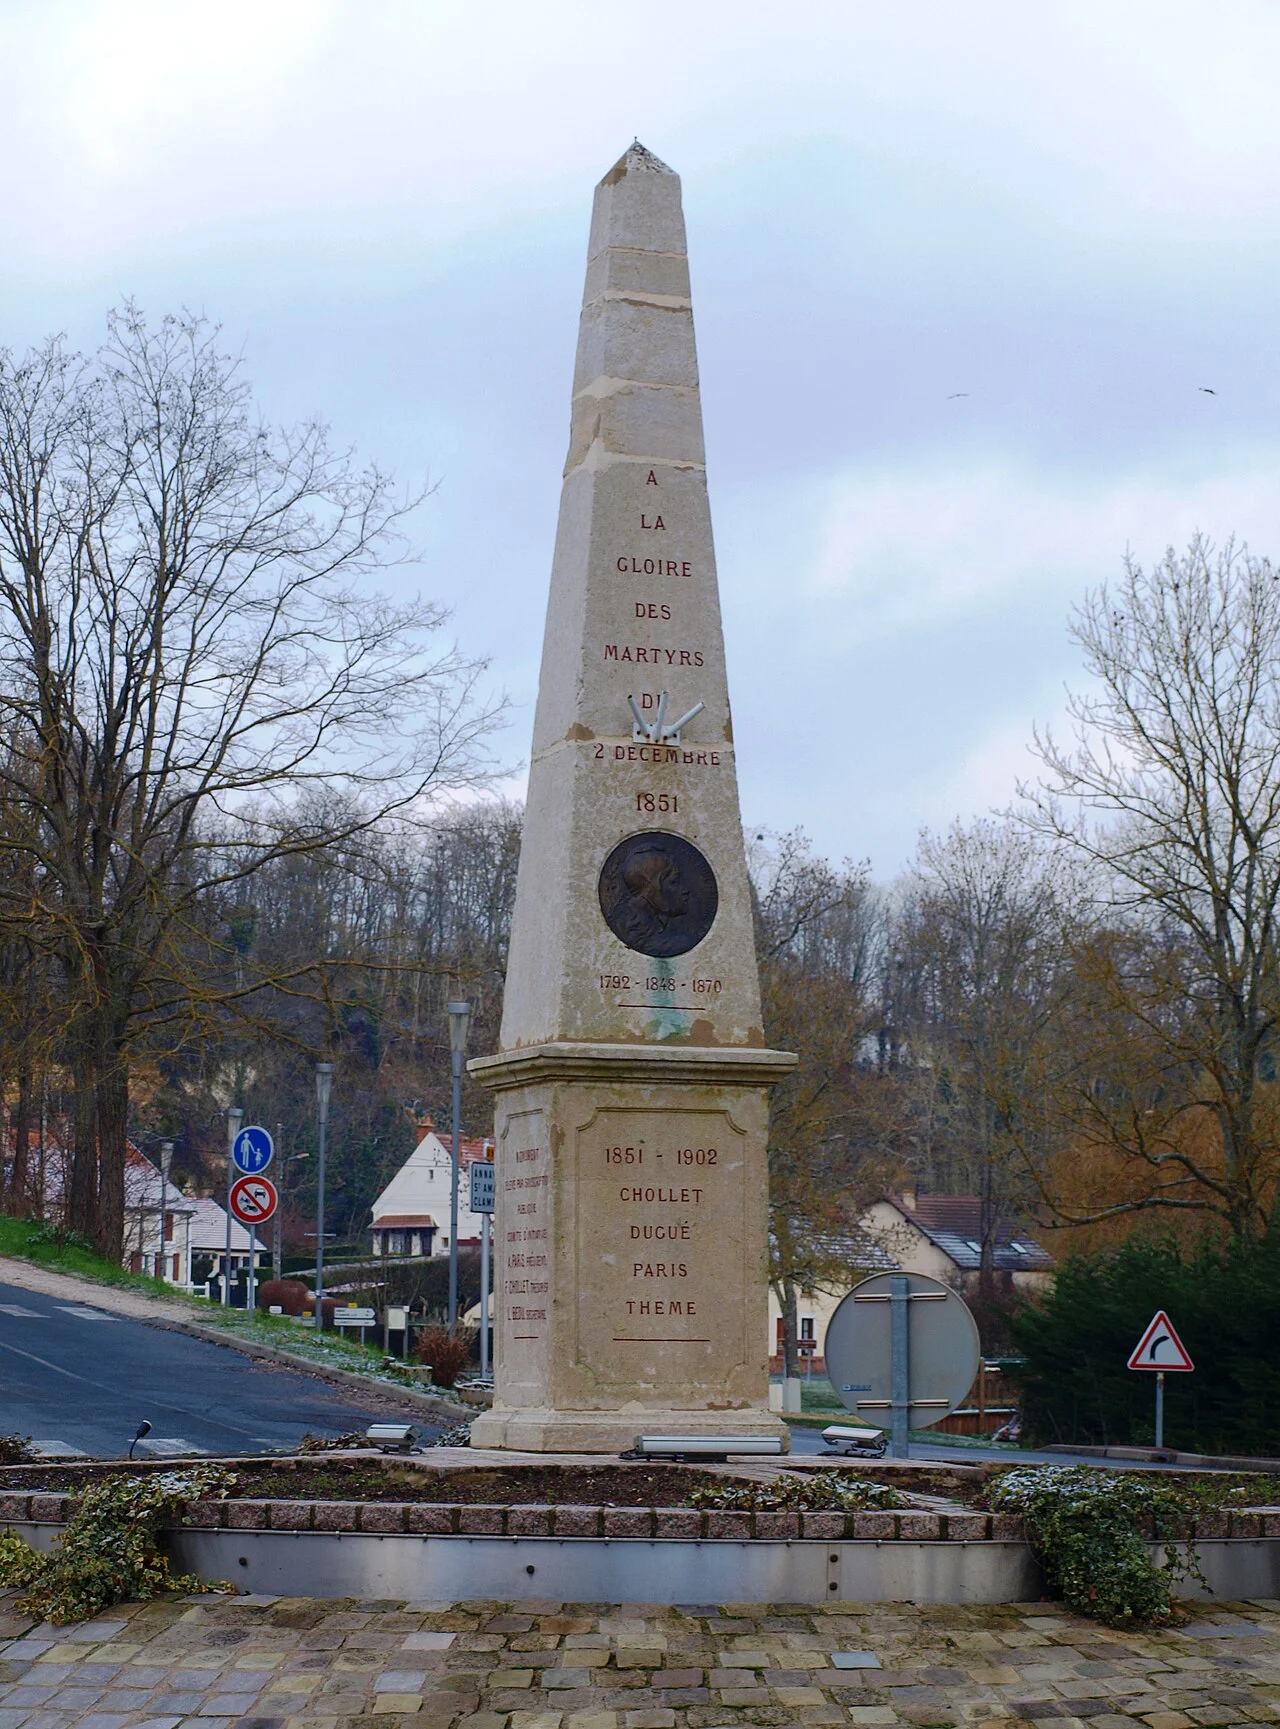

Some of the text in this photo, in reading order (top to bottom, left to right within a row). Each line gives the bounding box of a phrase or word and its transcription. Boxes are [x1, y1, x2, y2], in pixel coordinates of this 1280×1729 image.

[646, 470, 658, 486] A
[640, 514, 666, 531] LA
[616, 556, 692, 577] GLOIRE
[635, 603, 671, 620] DES
[603, 644, 704, 667] MARTYRS
[594, 743, 721, 766] 2 DECEMBRE
[635, 793, 679, 813] 1851
[600, 975, 631, 990] 1792
[645, 976, 676, 992] 1848
[692, 979, 722, 994] 1870
[606, 1147, 643, 1165] 1851
[677, 1148, 718, 1166] 1902
[619, 1187, 703, 1203] CHOLLET
[630, 1220, 691, 1240] DUGUÉ
[633, 1262, 688, 1278] PARIS
[626, 1301, 697, 1315] THEME
